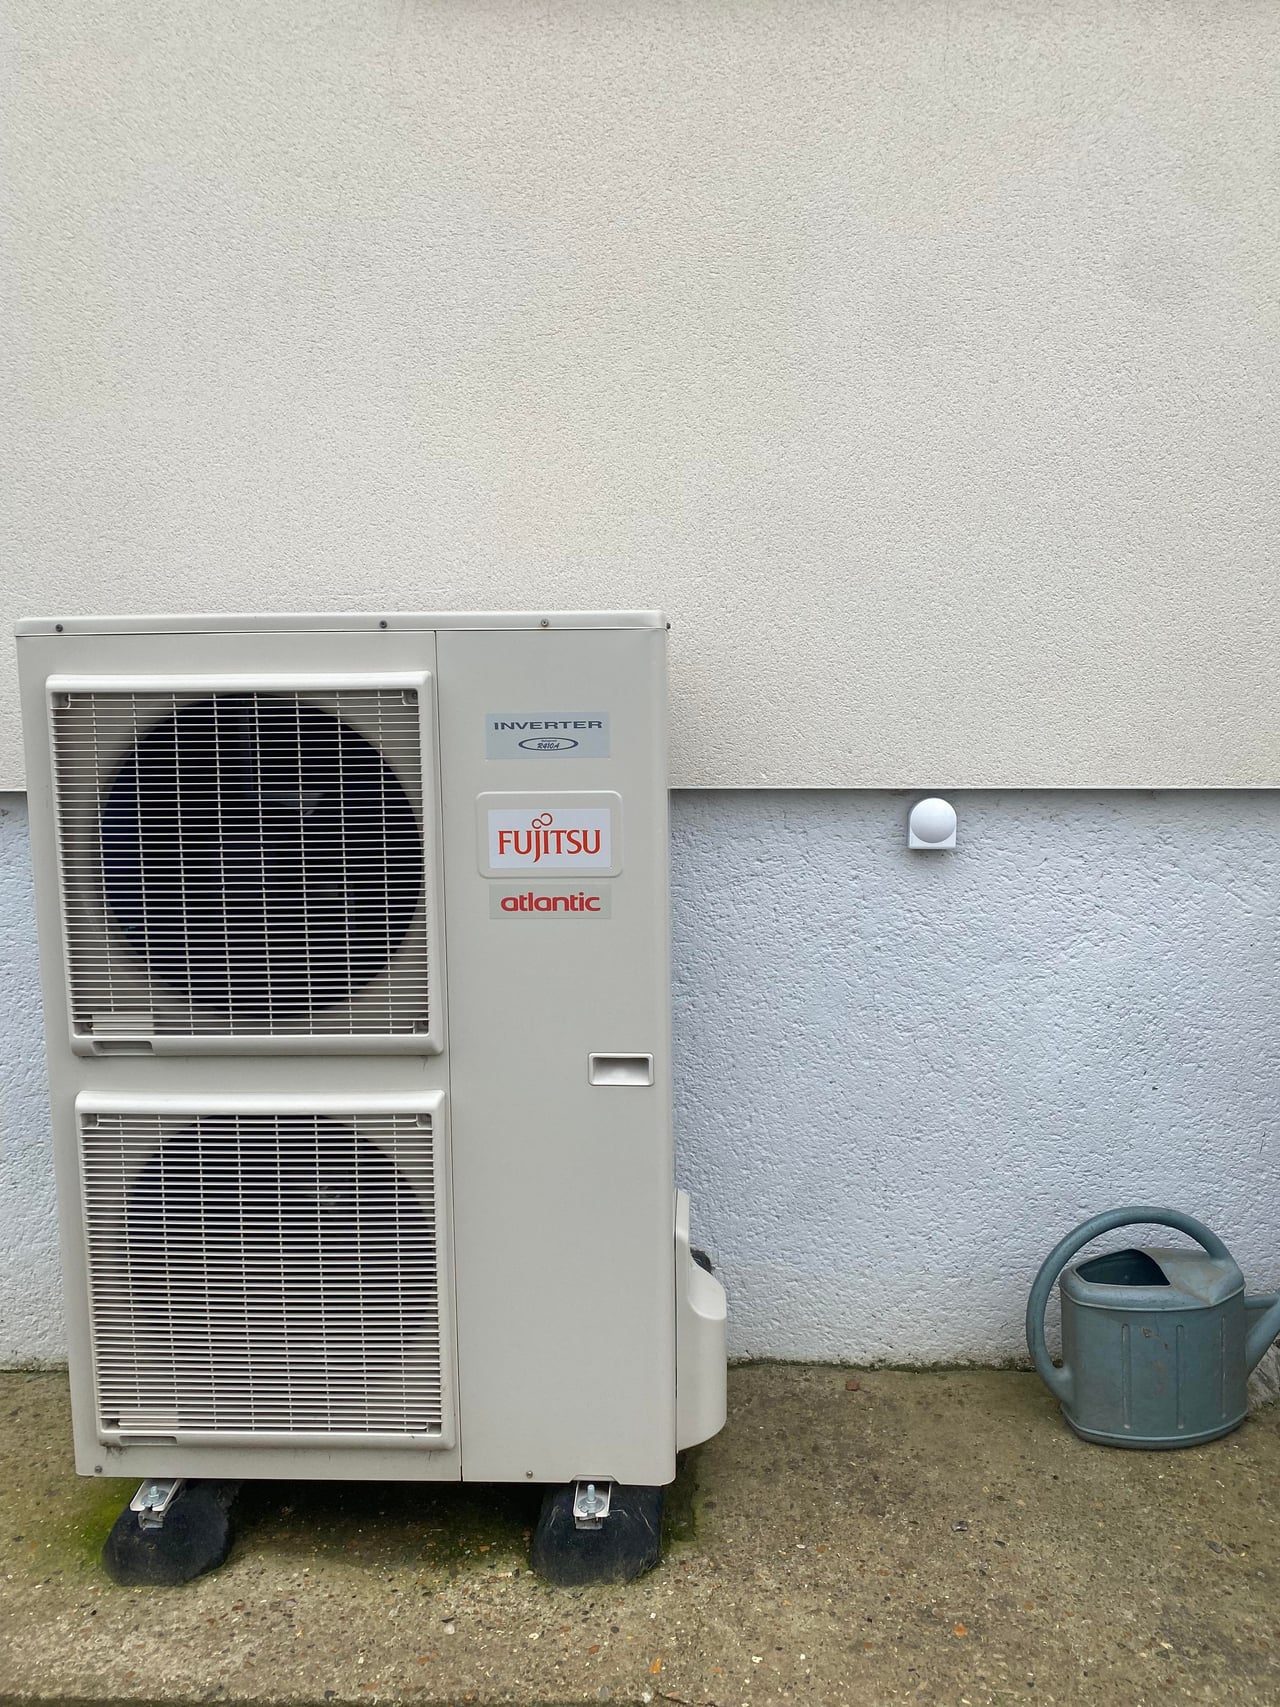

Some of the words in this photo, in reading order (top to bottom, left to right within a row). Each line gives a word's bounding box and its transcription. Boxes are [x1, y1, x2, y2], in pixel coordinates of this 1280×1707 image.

[494, 720, 603, 730] INVERTER
[497, 828, 601, 863] FUJITSU
[500, 892, 601, 912] atlantic
